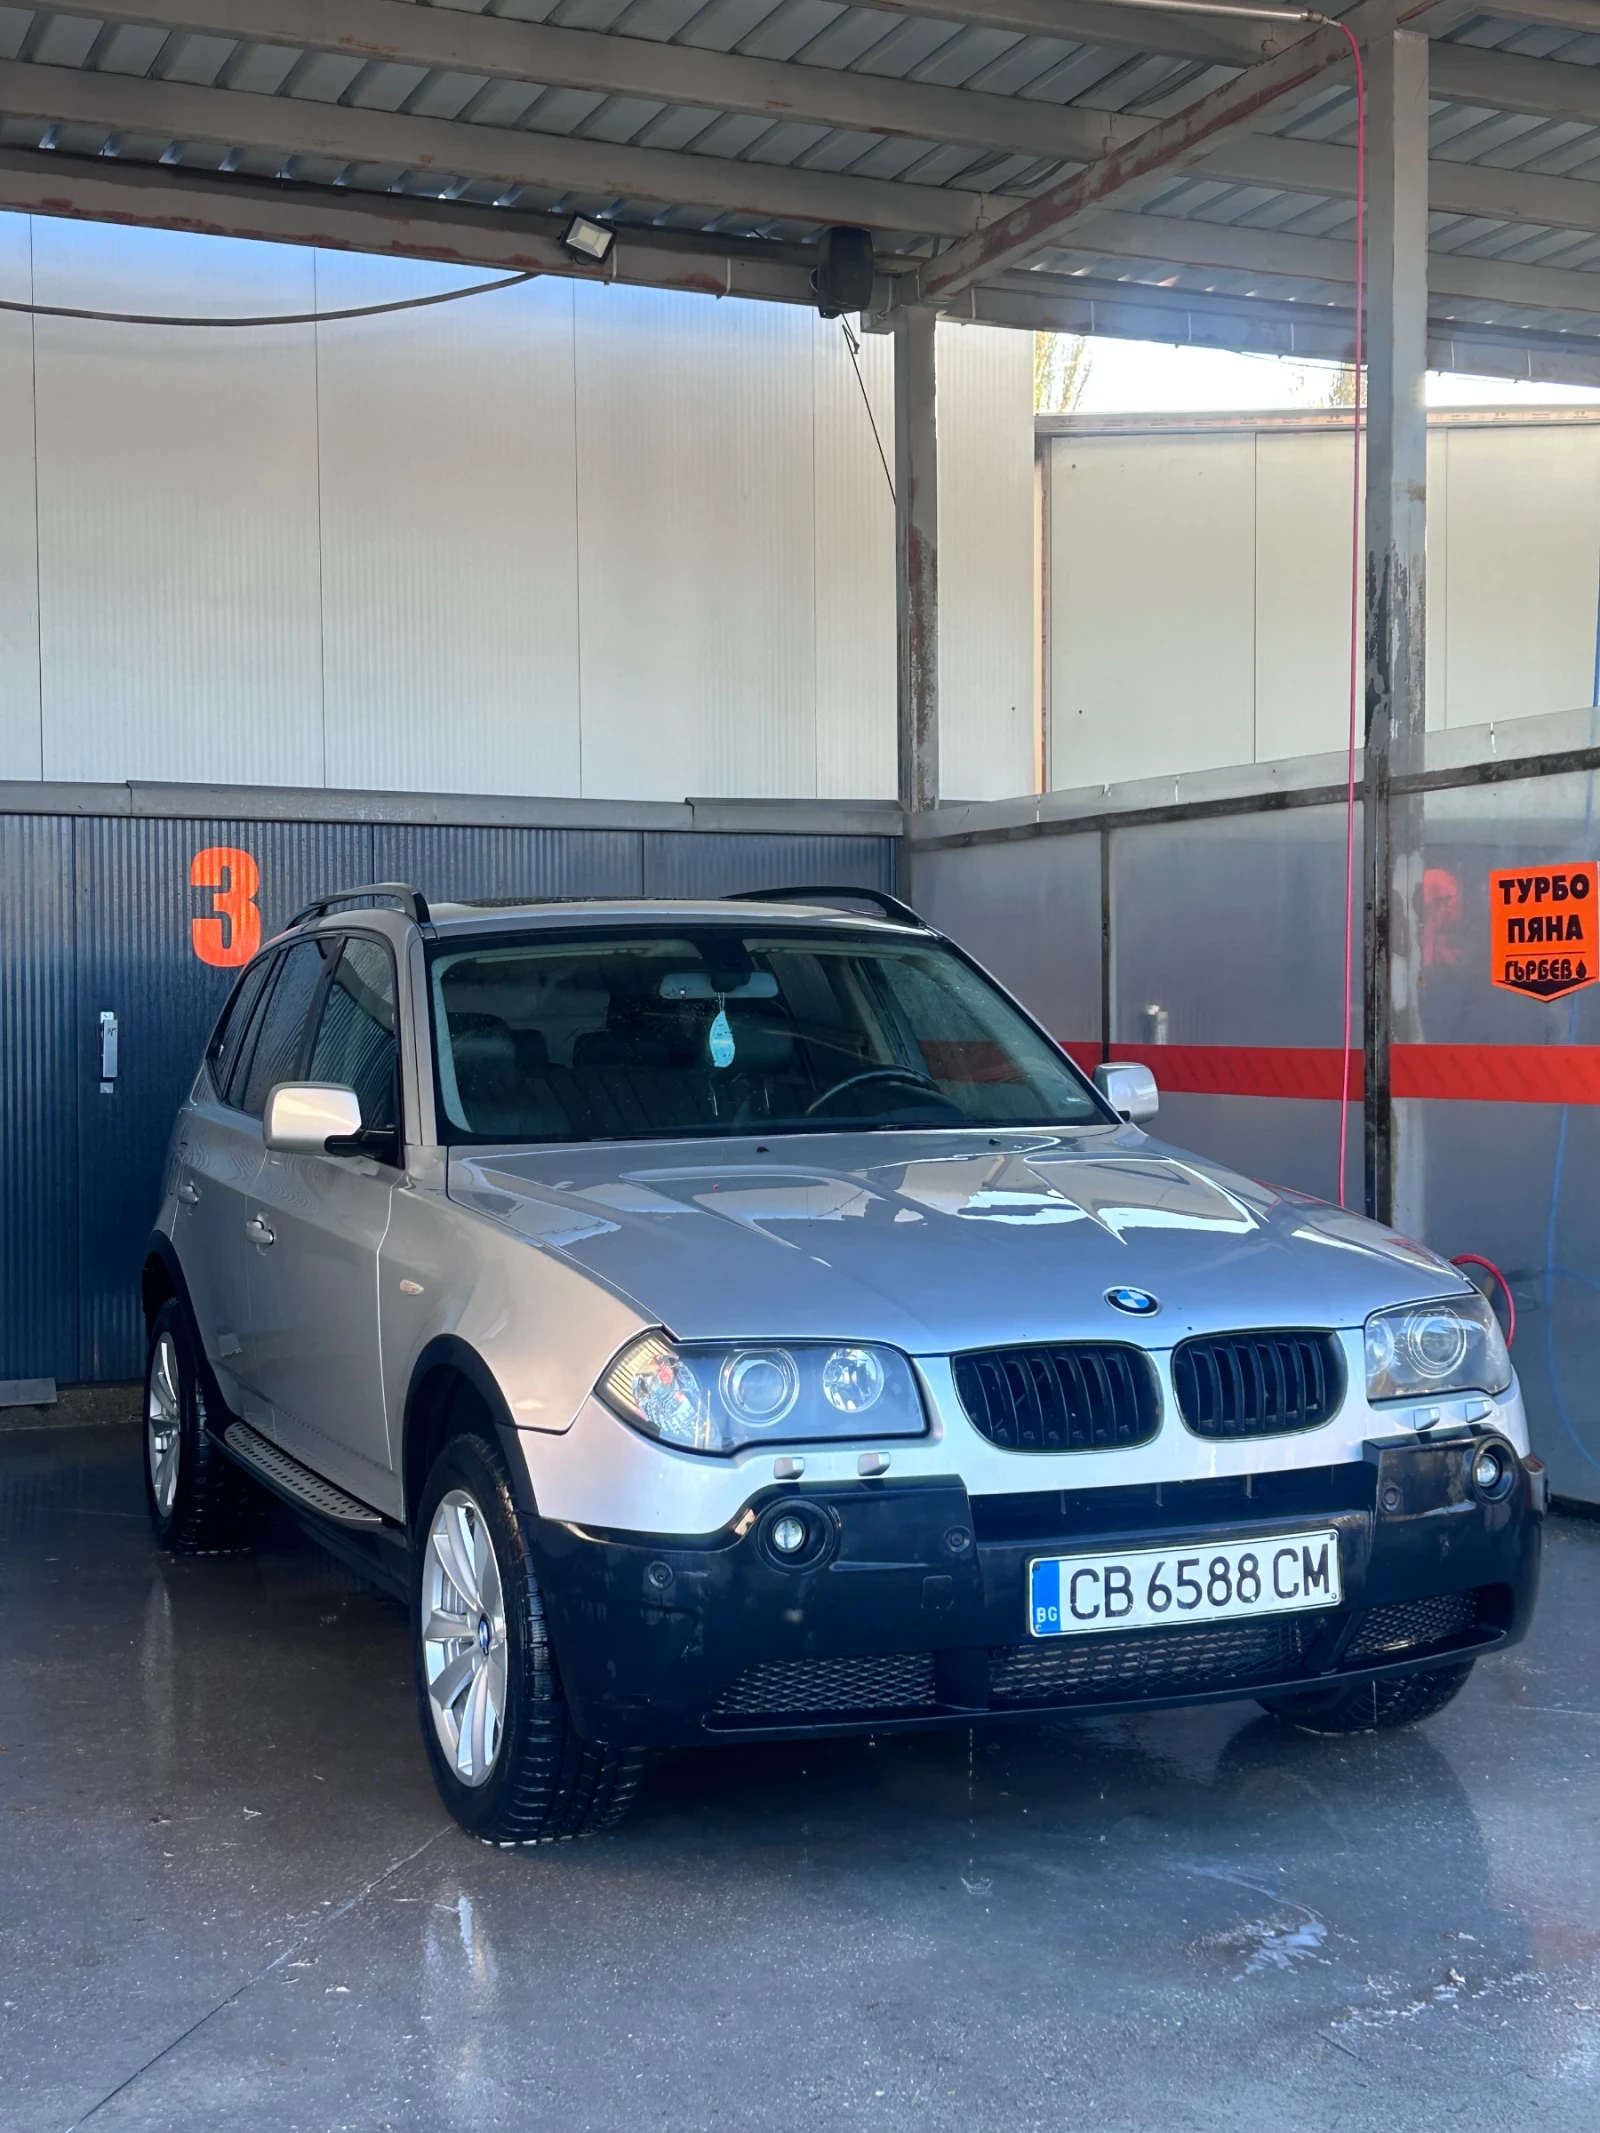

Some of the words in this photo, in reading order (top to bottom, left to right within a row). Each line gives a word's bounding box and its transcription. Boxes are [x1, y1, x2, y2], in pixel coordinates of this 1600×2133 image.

[191, 847, 261, 967] 3
[1499, 874, 1590, 905] ТУРБО
[1508, 914, 1584, 943] ПЯНА
[1036, 1606, 1058, 1623] BG
[1069, 1565, 1134, 1620] CB
[1146, 1553, 1261, 1613] 6588
[1272, 1543, 1330, 1599] CM
